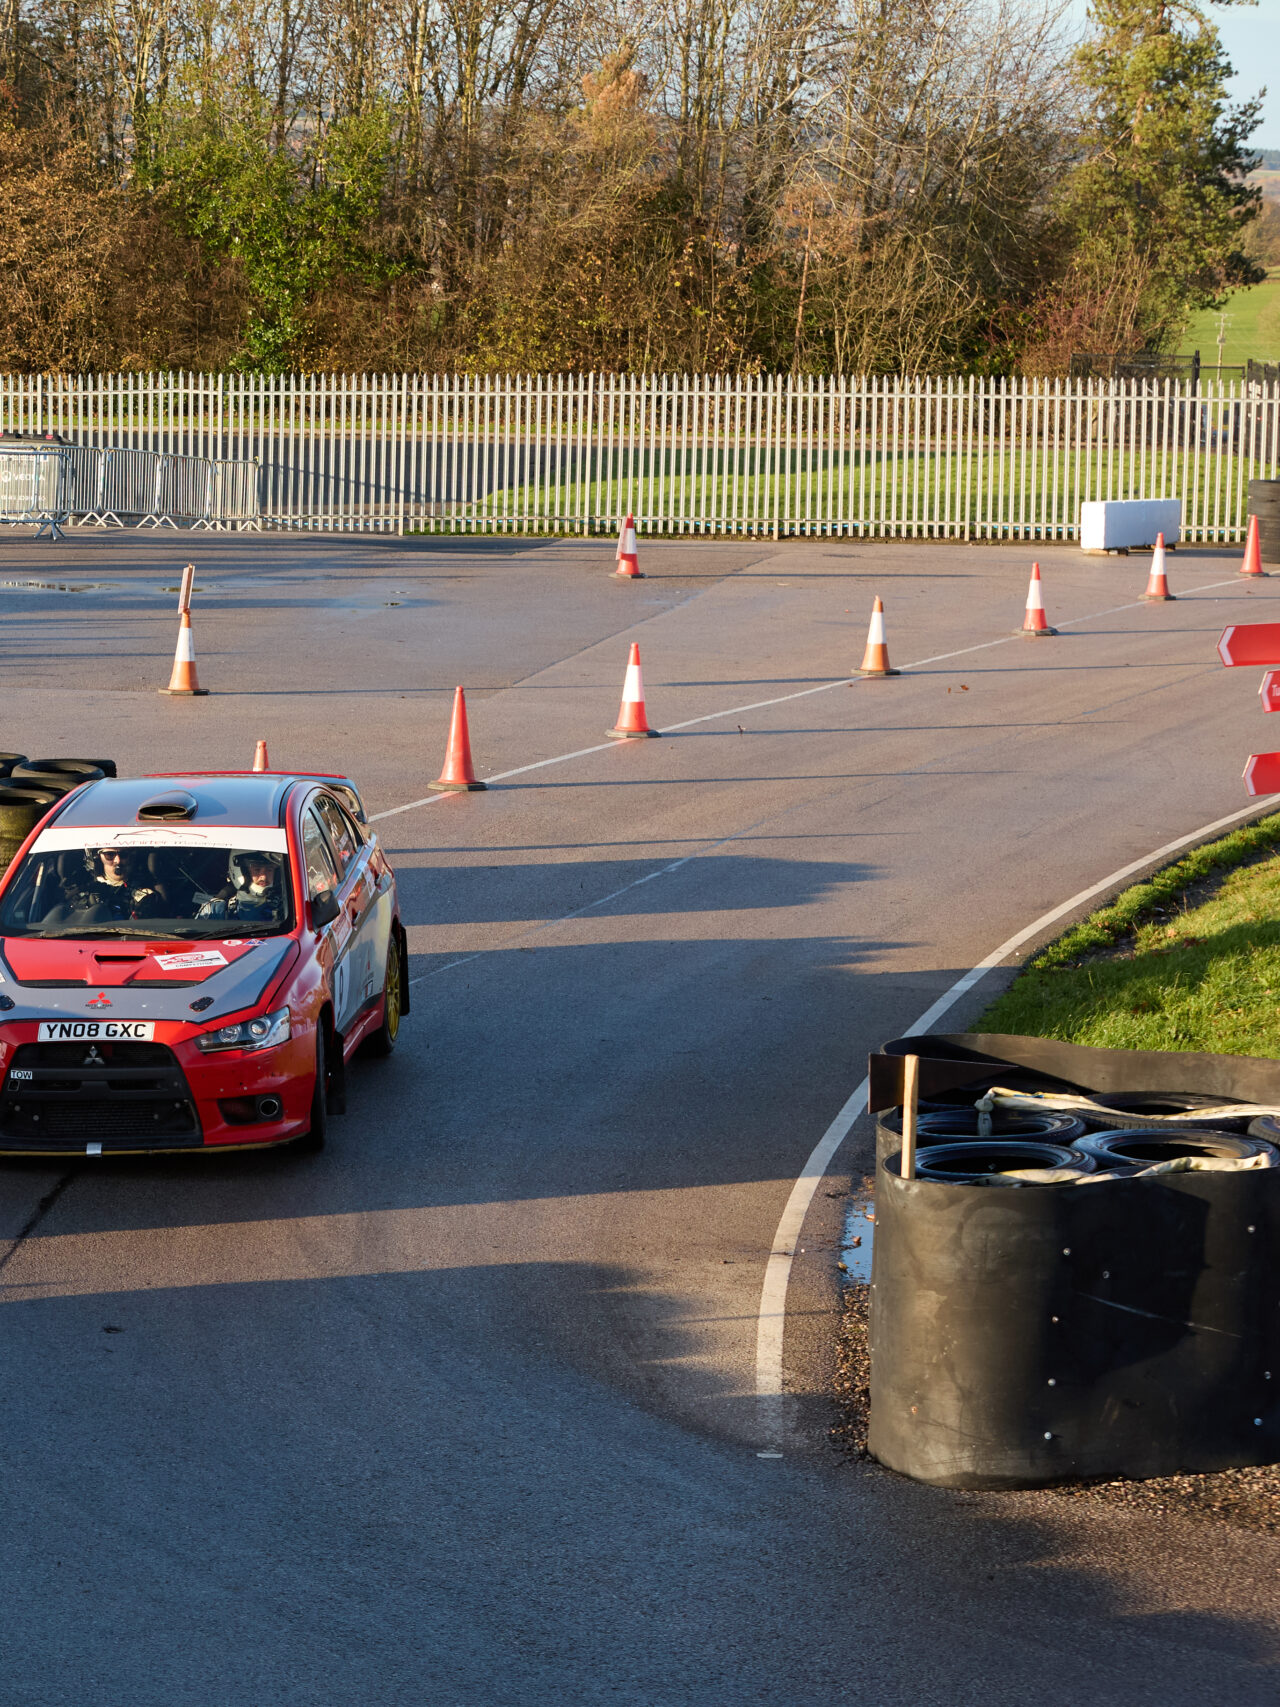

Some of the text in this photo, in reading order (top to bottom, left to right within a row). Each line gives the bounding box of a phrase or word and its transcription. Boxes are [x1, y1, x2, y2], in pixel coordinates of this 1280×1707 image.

[46, 1023, 147, 1038] YN08 GXC
[11, 1070, 32, 1079] TOW
